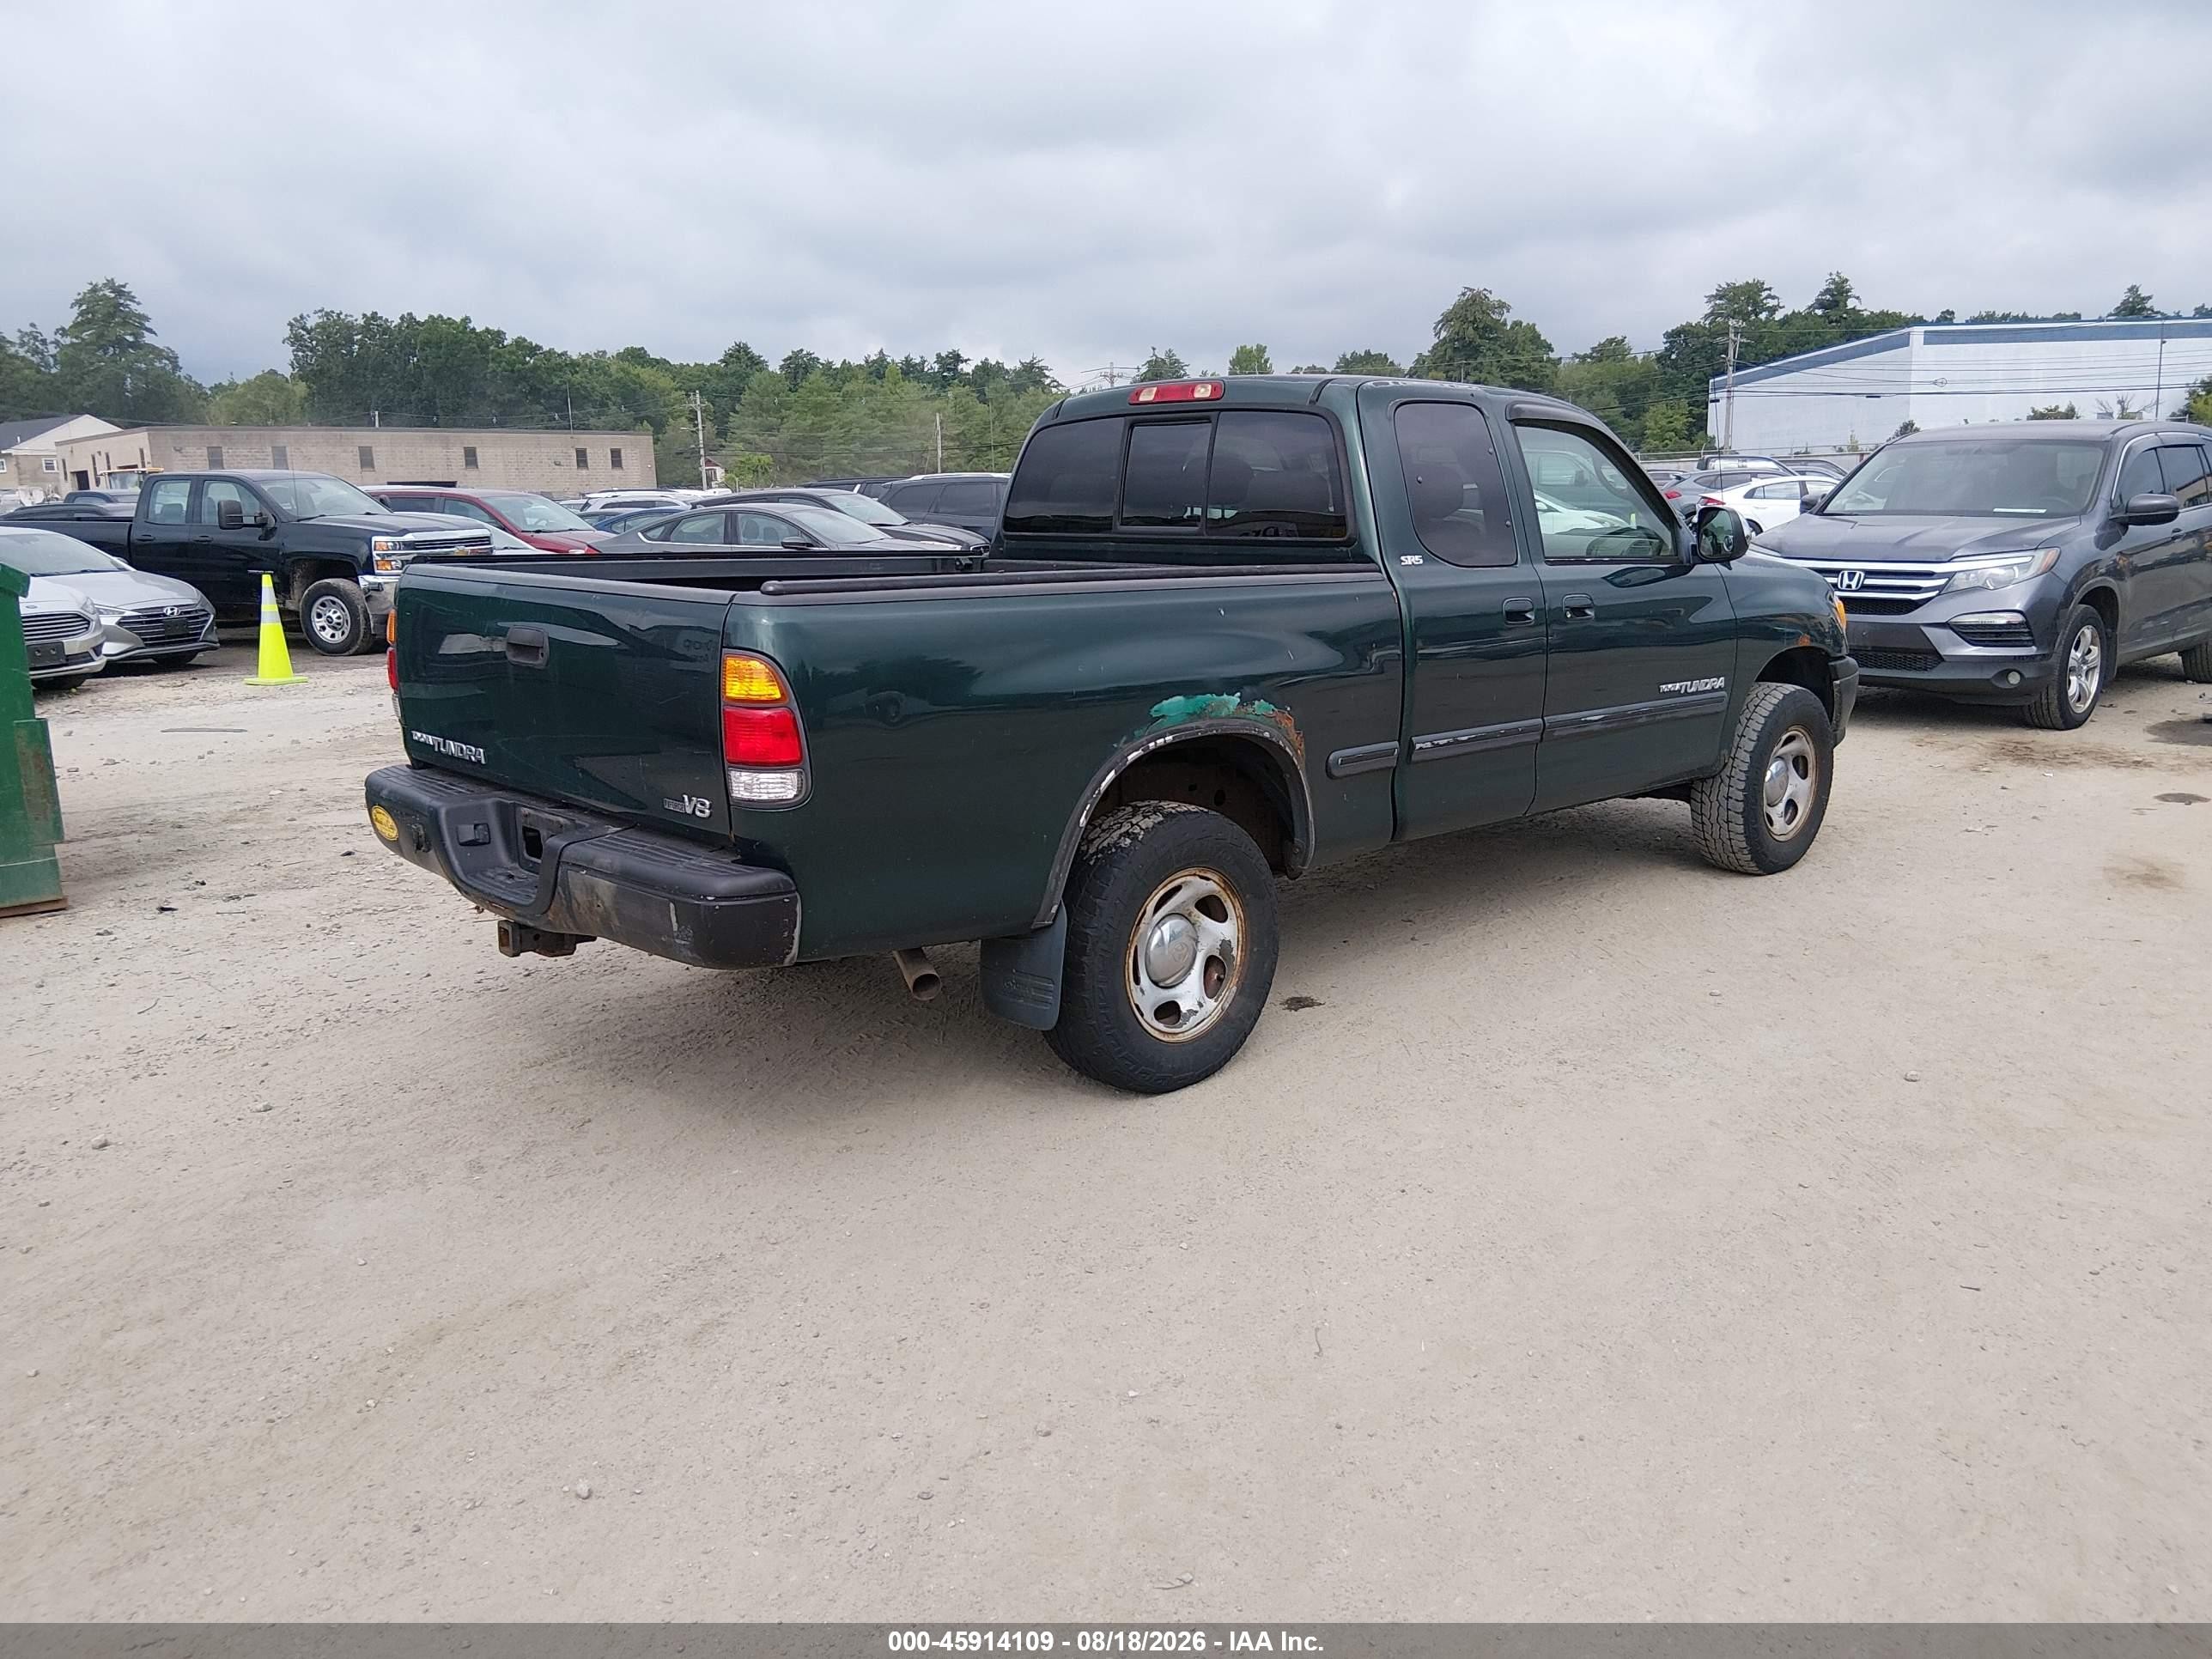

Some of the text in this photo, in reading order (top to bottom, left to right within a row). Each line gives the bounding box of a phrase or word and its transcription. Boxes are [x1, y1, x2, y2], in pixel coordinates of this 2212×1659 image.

[1400, 555, 1424, 565] SR5
[1679, 677, 1725, 694] TUNDRA
[432, 736, 486, 765] TUNDRA
[683, 794, 711, 817] V8
